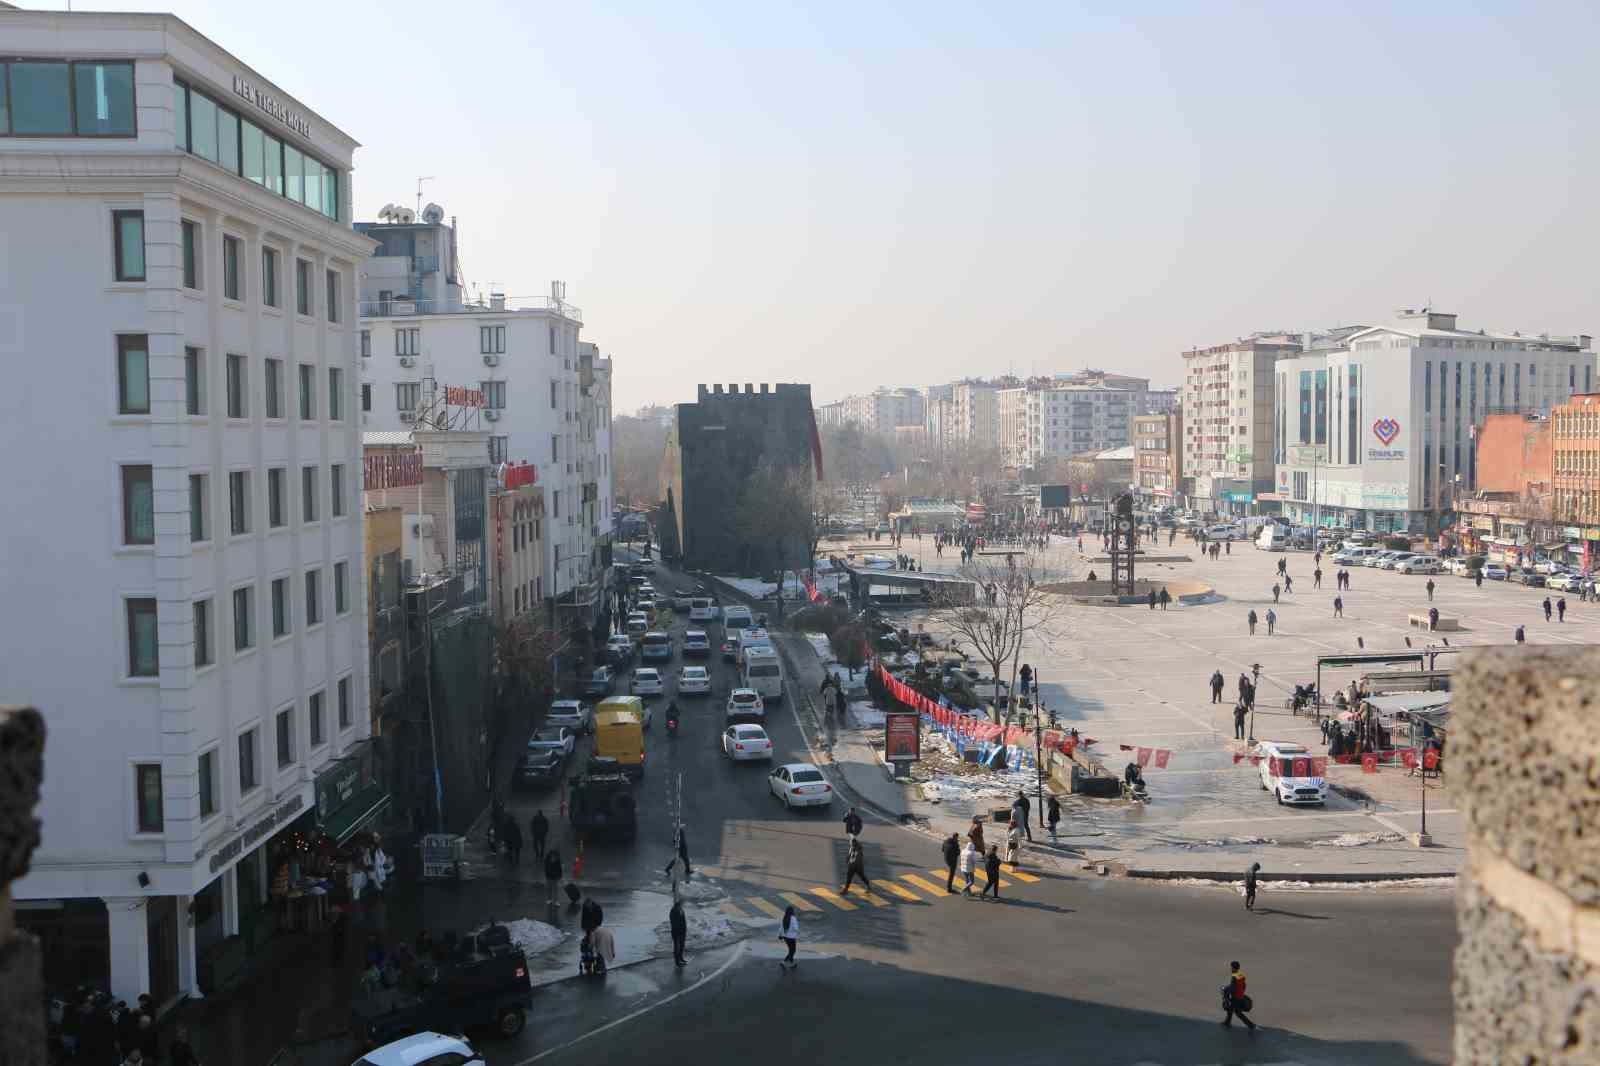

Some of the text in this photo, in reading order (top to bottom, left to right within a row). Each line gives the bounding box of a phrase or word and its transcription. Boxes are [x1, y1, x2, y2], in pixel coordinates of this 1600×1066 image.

[234, 76, 312, 139] NEW TIGRIS HOTEL
